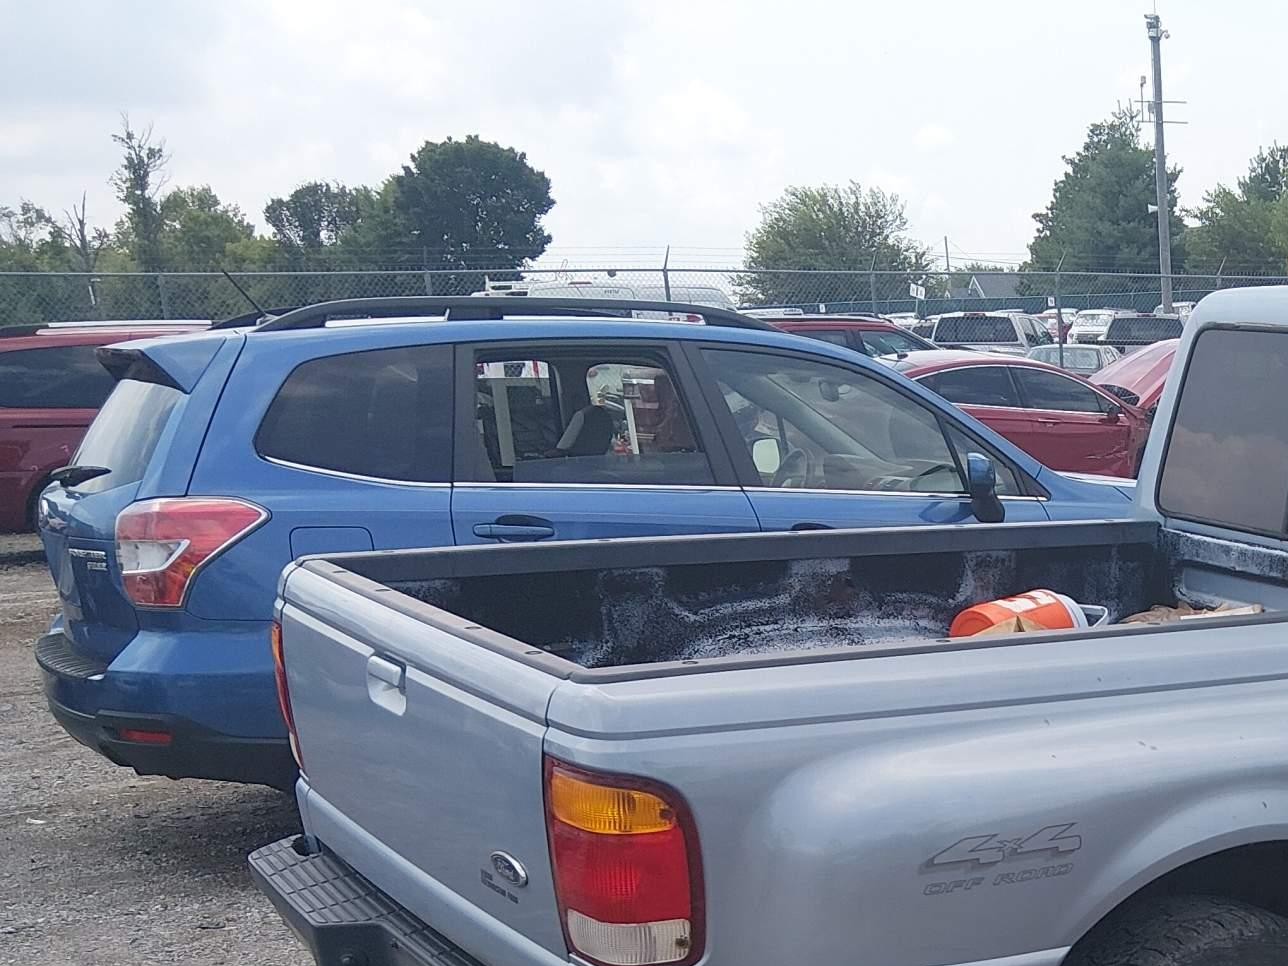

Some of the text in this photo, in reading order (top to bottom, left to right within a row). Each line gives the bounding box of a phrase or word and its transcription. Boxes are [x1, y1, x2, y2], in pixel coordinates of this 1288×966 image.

[924, 822, 1082, 870] 4x4
[923, 863, 1074, 896] OFF ROAD
